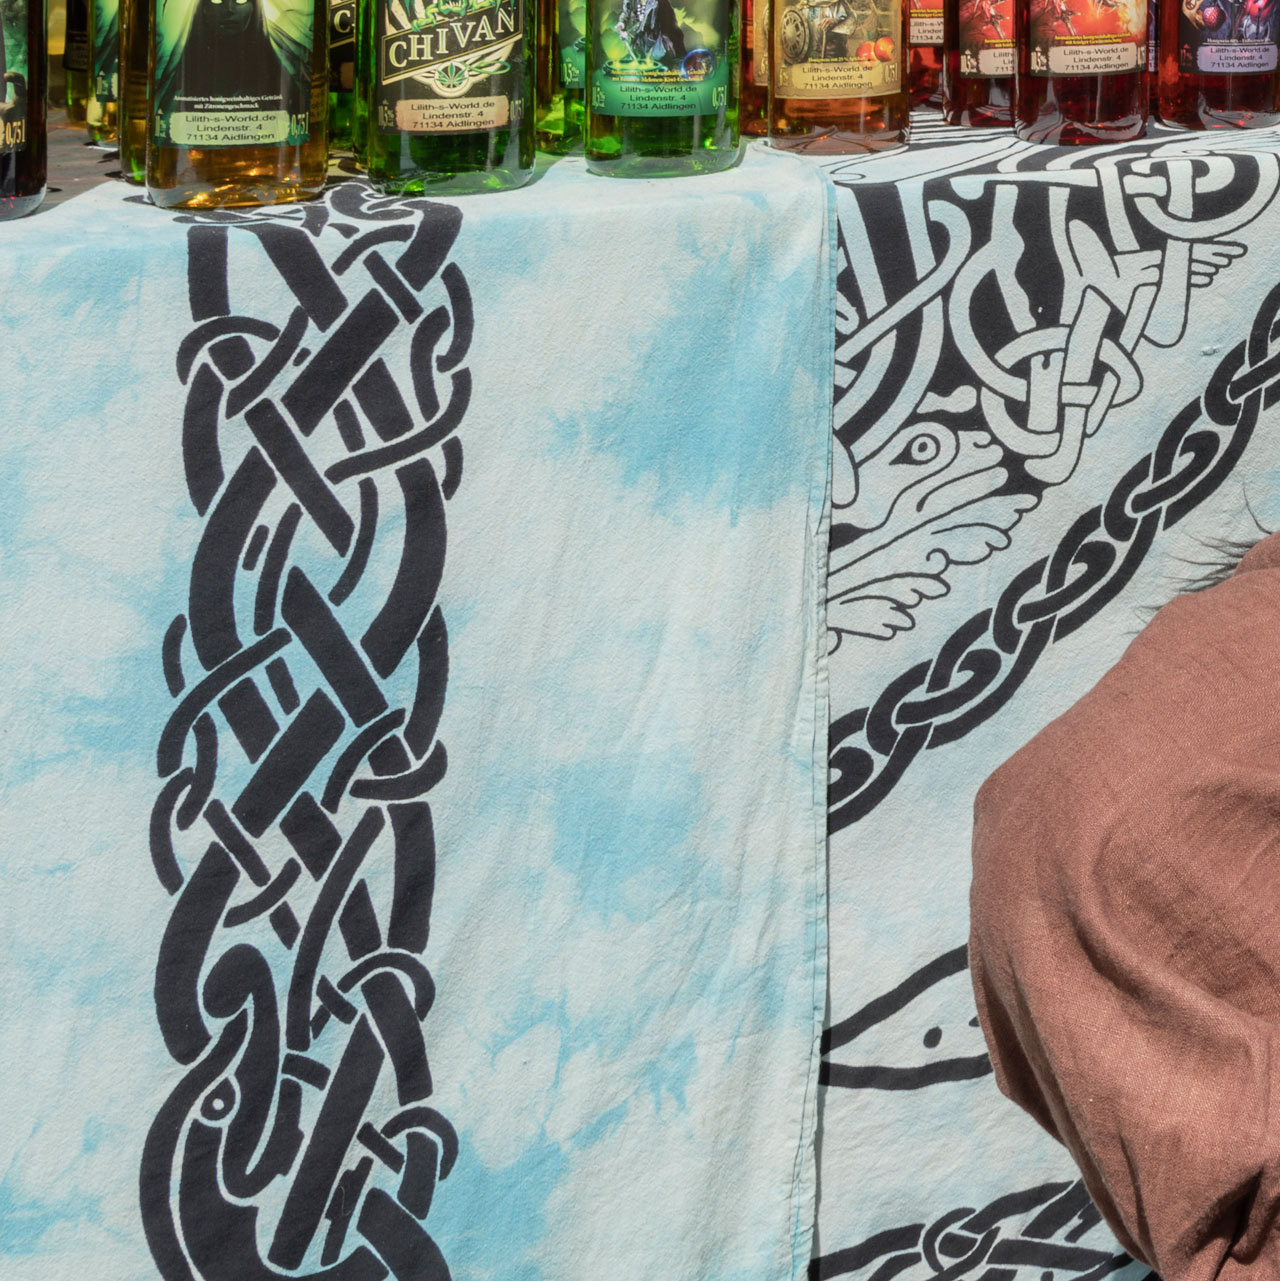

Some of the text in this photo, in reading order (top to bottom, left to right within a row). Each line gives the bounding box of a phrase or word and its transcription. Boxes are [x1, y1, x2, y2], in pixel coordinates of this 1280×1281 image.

[388, 7, 516, 68] CHIVAN
[1063, 47, 1129, 56] Lilith-s-World.de
[1073, 56, 1112, 64] Lindenstr.
[1064, 61, 1129, 72] 71134 Aidlingen
[619, 85, 697, 94] Lilith-s-World.de
[804, 82, 830, 90] 71134
[629, 94, 676, 102] Lindenstr.
[410, 101, 495, 111] Lilith-s-World.de
[621, 101, 696, 111] 71134 Aidlingen
[185, 114, 277, 123] Lilith-s-World.de
[422, 110, 484, 120] Lindenstr. 4
[196, 123, 263, 132] Lindenstr. 4
[412, 119, 495, 129] 71134 Aidlingen
[186, 132, 275, 142] 71134 Aidlingen
